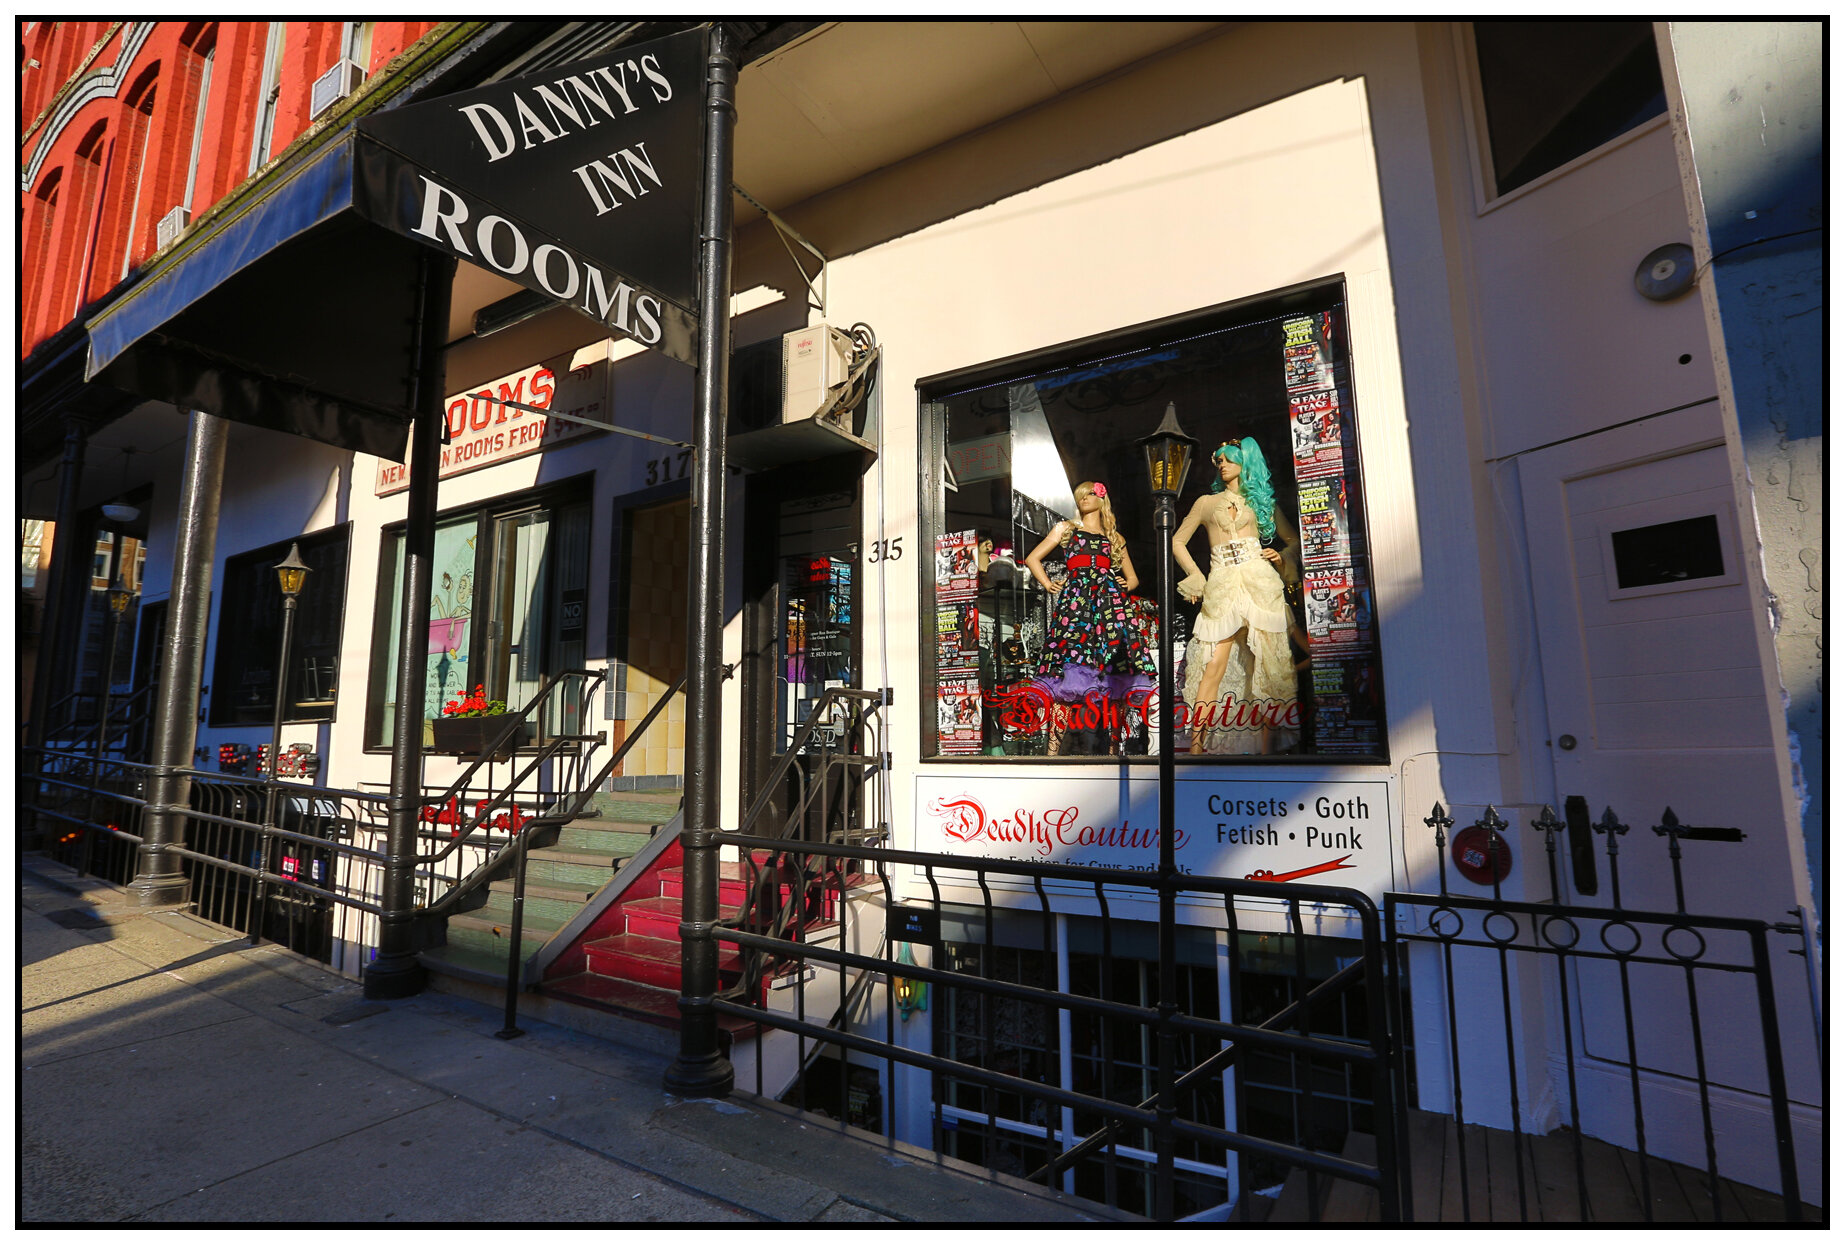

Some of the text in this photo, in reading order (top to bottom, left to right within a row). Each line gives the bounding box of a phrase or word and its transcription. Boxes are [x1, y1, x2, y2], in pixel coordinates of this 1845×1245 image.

[458, 53, 673, 163] DANNY'S
[572, 142, 663, 217] INN
[411, 174, 663, 345] ROOMS
[447, 368, 555, 439] OOMS
[382, 464, 406, 486] NEW
[454, 433, 504, 465] ROOMS
[509, 418, 549, 448] FROM
[646, 450, 692, 486] 317
[1298, 486, 1331, 496] UNIFORM
[1301, 502, 1328, 514] BALL
[868, 538, 903, 563] 315
[926, 791, 1192, 856] Deadly Couture
[1208, 794, 1369, 820] Corsets Goth
[1217, 823, 1363, 850] Fetish Punk
